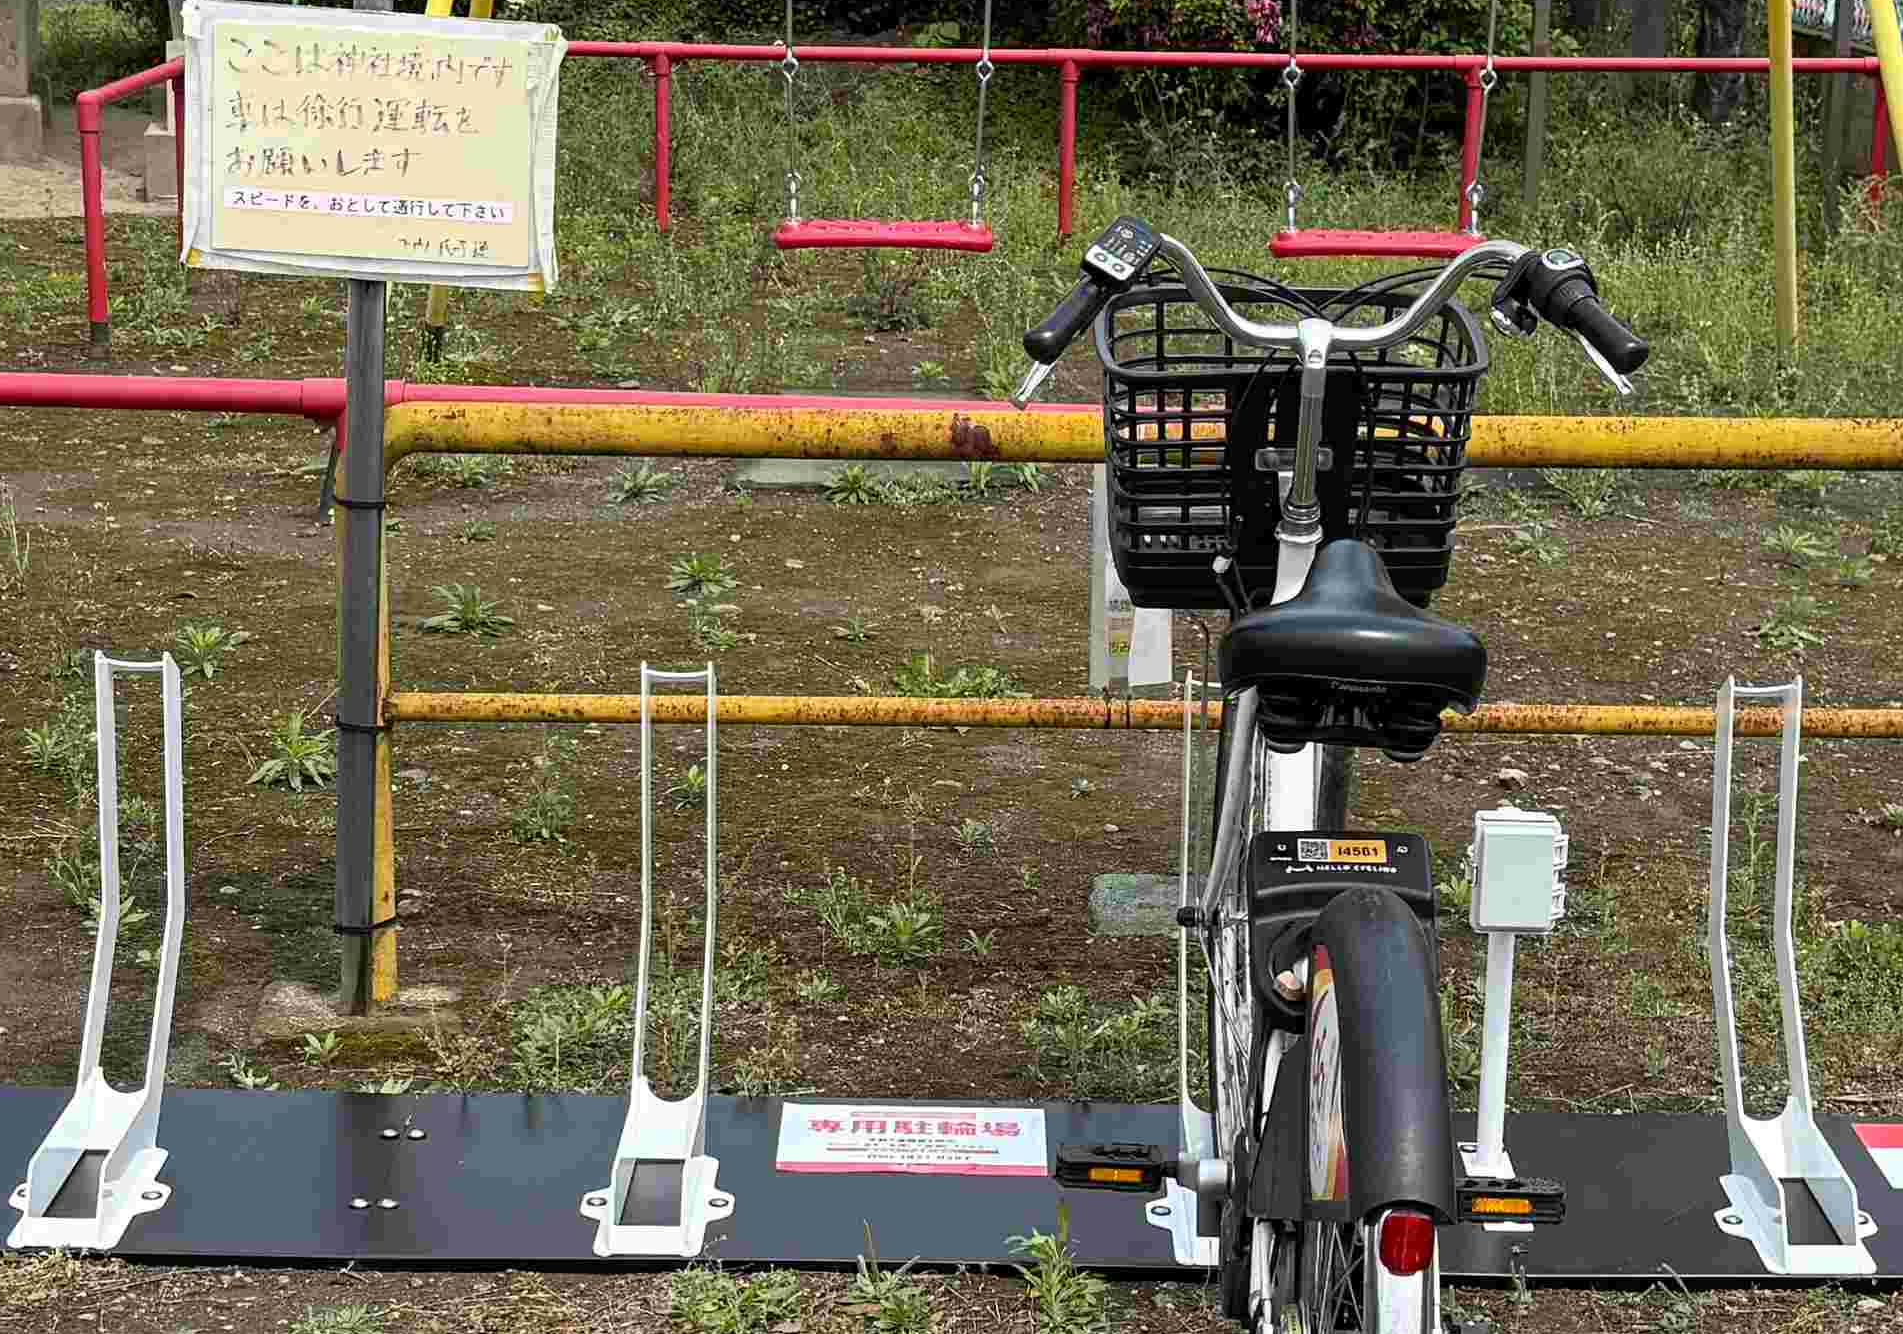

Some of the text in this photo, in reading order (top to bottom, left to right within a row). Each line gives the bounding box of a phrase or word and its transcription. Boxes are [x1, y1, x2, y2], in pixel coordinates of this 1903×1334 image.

[224, 145, 423, 179] お願いします
